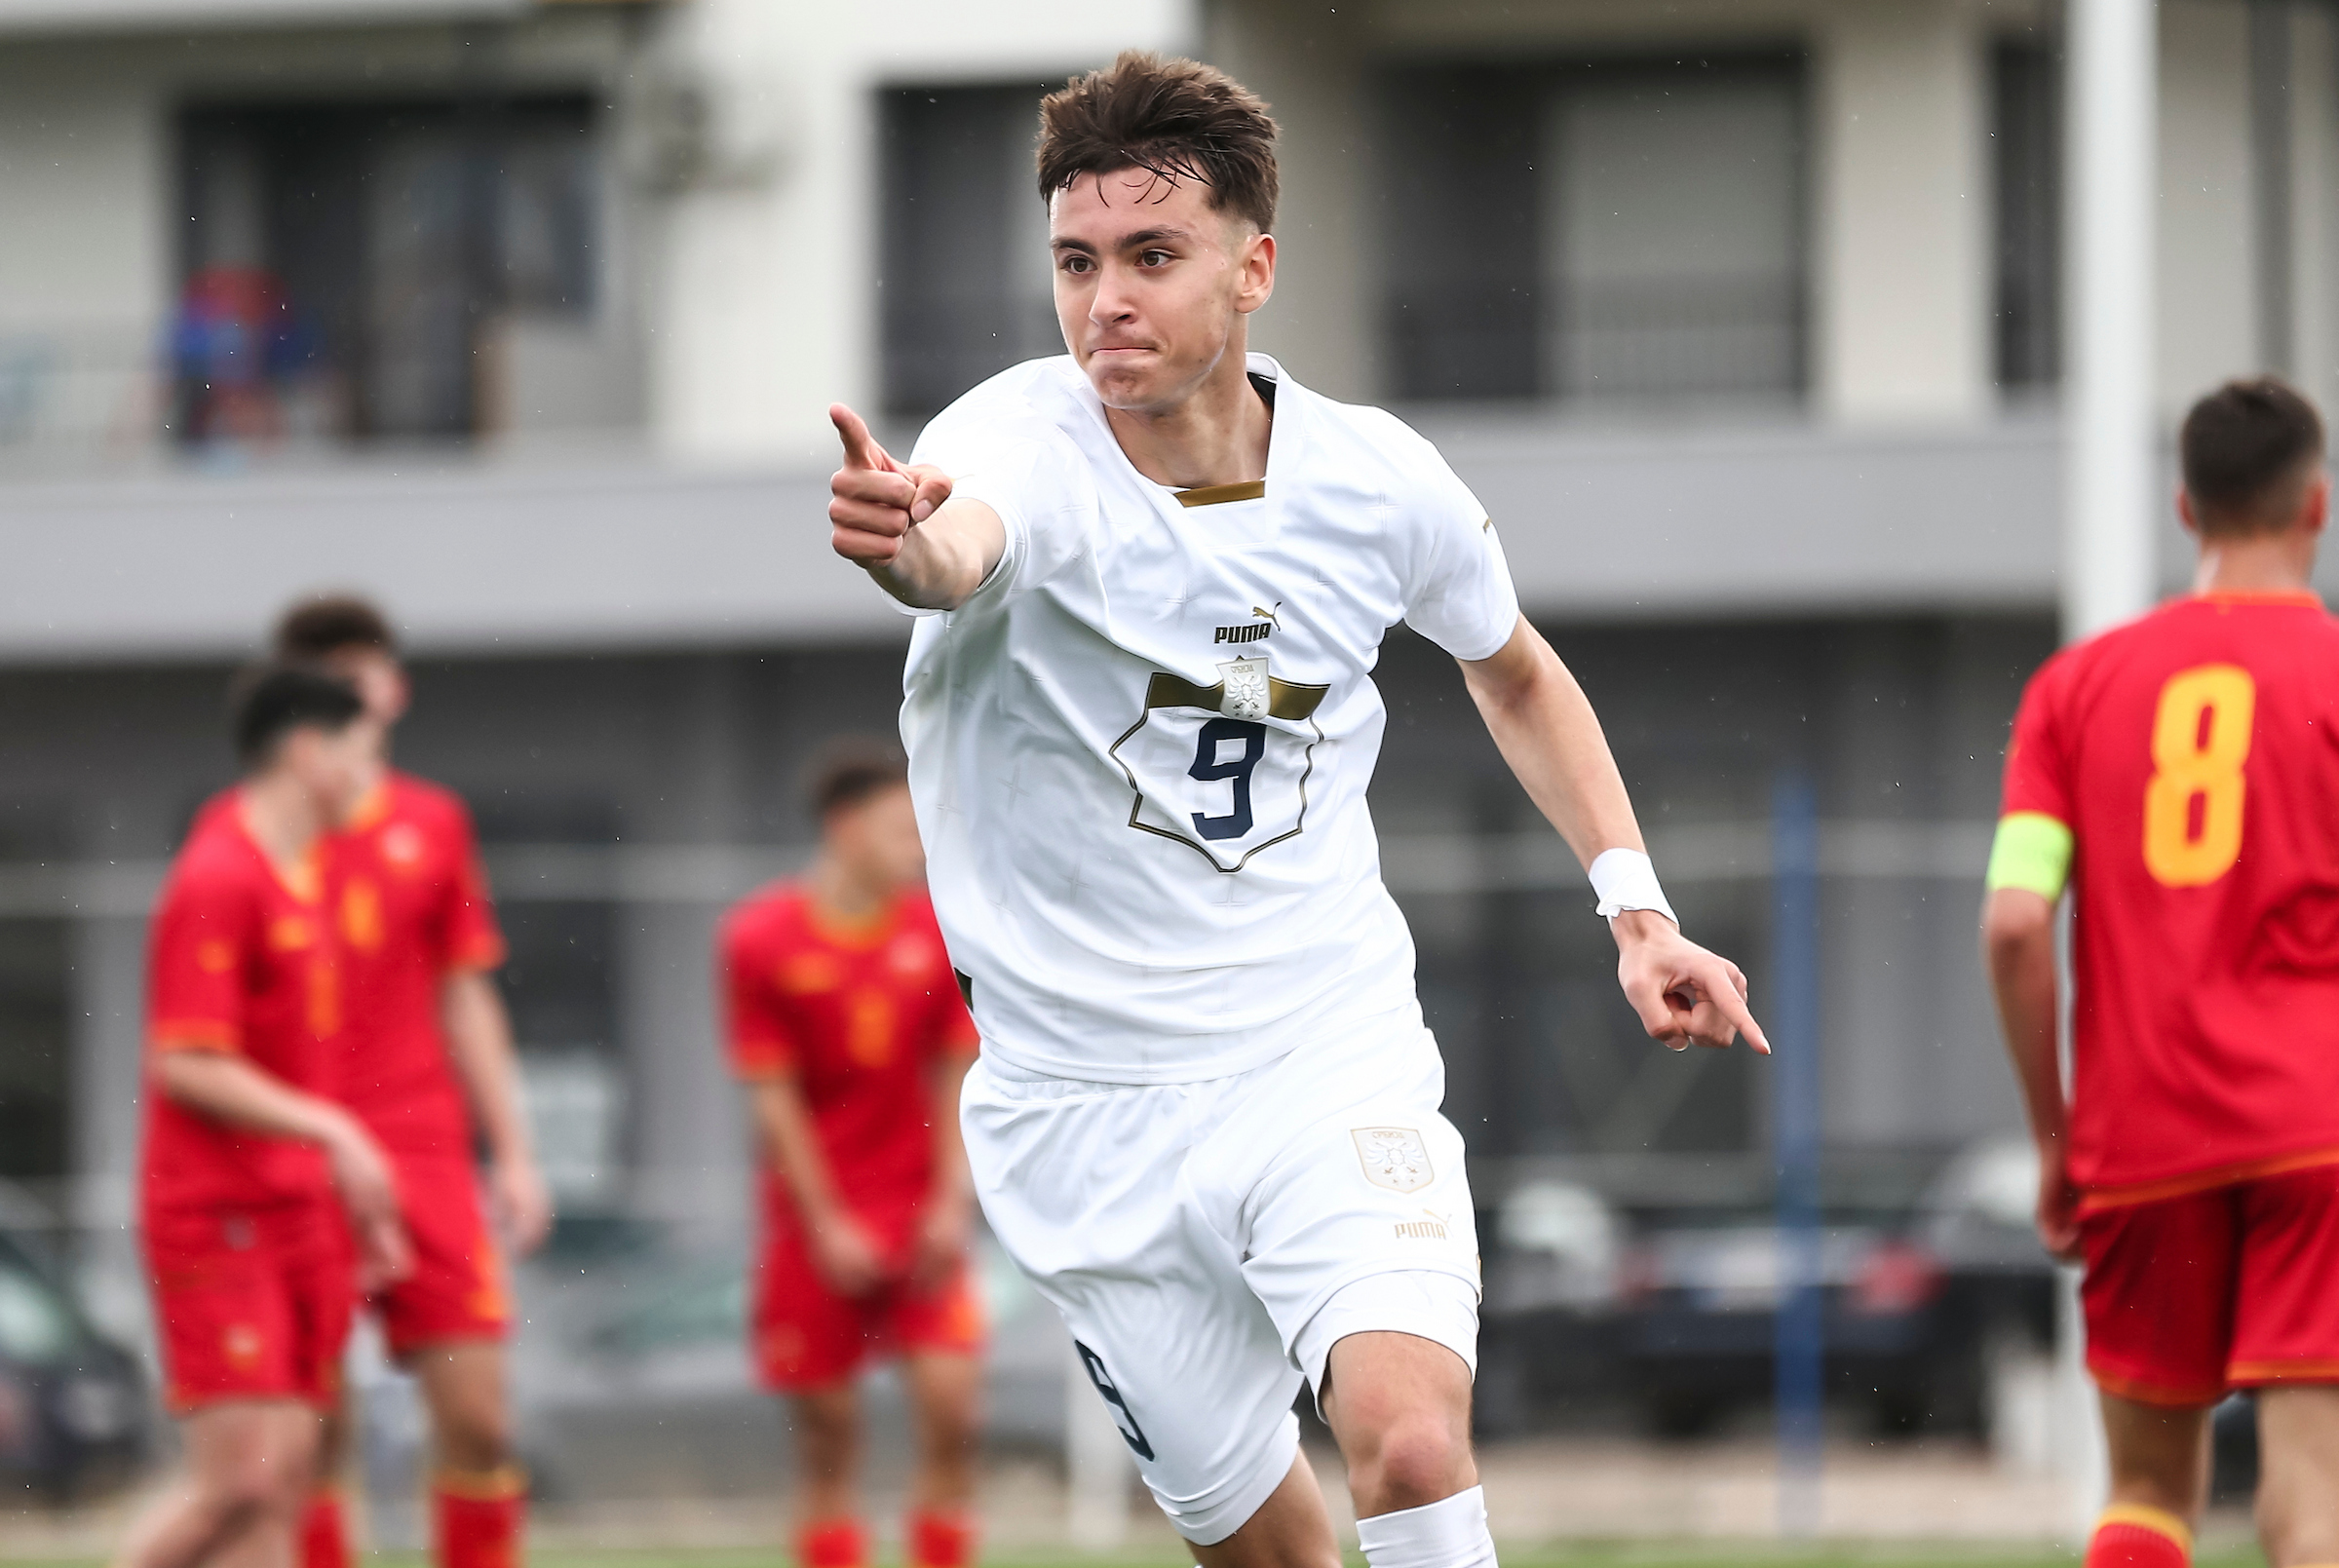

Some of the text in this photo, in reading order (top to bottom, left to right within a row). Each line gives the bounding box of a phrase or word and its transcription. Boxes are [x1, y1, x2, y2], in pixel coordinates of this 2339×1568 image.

[1214, 623, 1271, 644] PUMA
[1188, 717, 1267, 841] 9
[2143, 663, 2255, 889] 8
[1395, 1222, 1447, 1240] PUMA
[1074, 1339, 1155, 1462] 9
